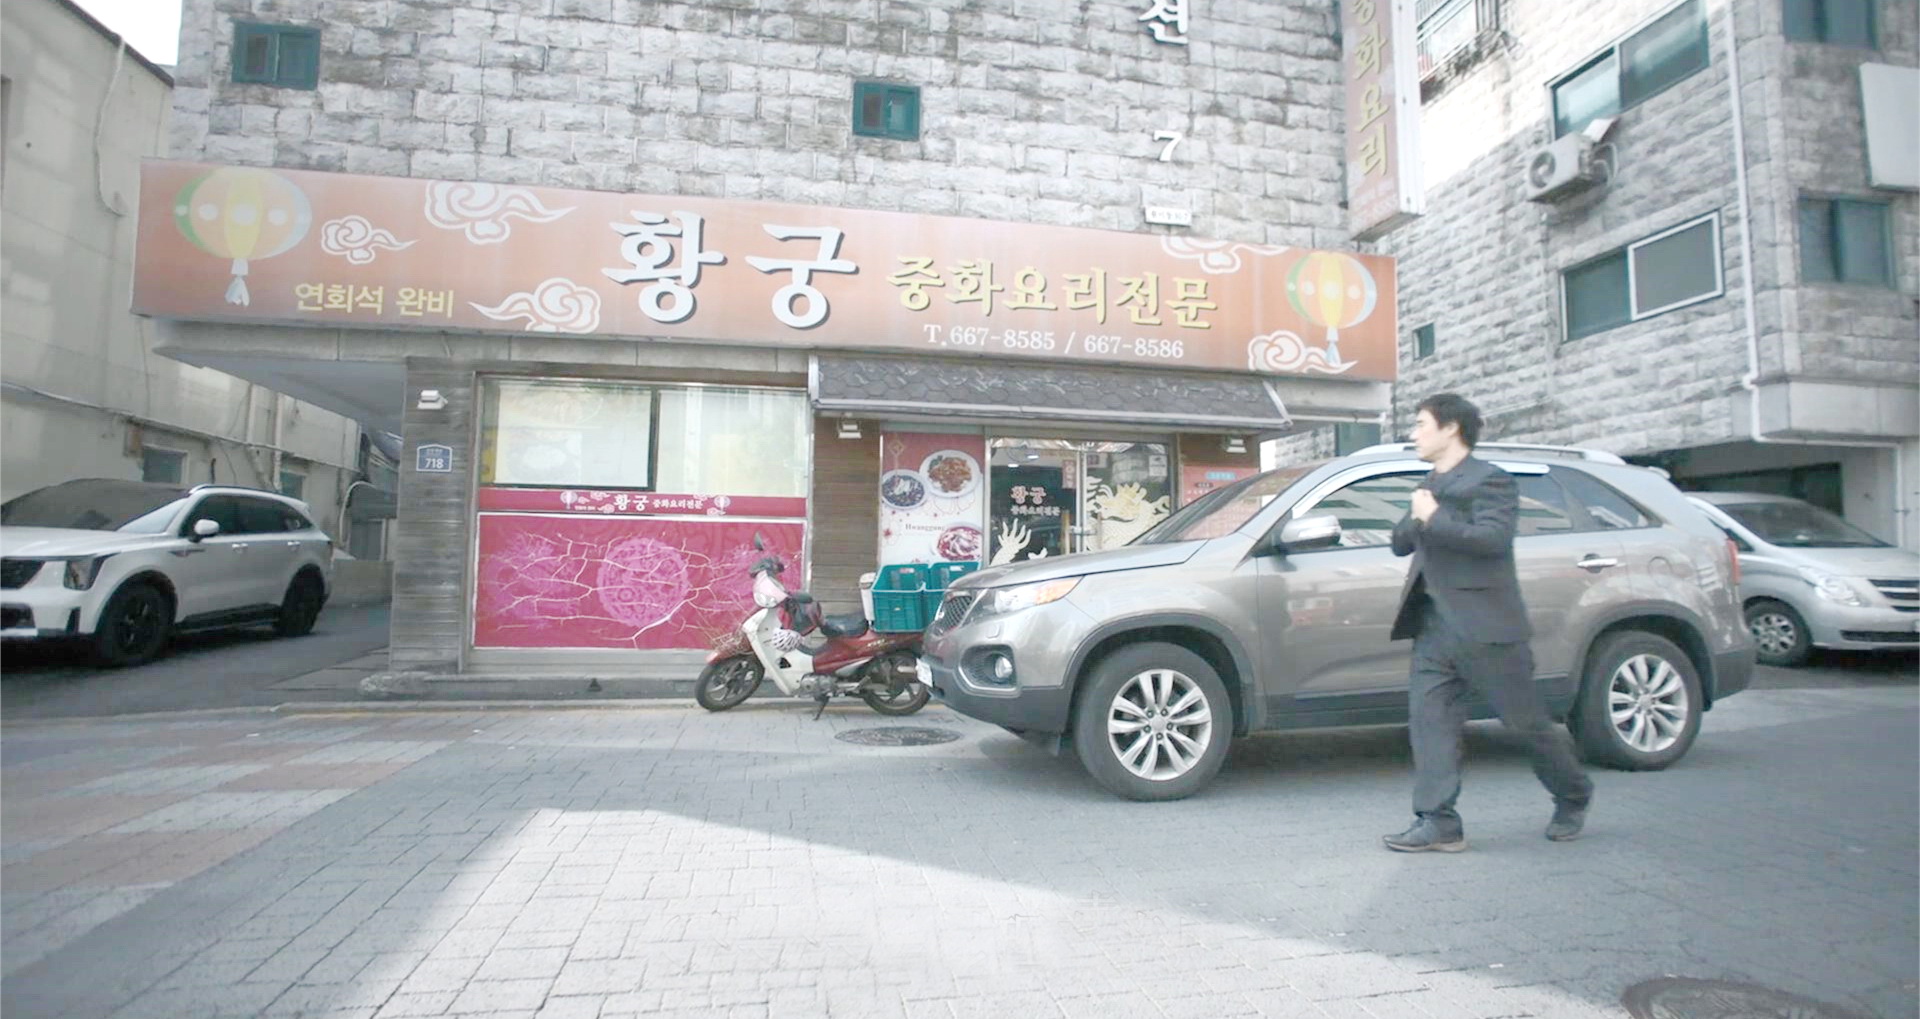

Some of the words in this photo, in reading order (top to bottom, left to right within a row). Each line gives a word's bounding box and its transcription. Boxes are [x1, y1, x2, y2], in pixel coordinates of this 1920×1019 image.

[1152, 130, 1183, 162] 7
[294, 282, 385, 316] 연회석
[395, 286, 455, 319] 완비
[885, 256, 1219, 329] 중화요리전문
[1083, 334, 1185, 359] 667-8586
[424, 457, 445, 469] 718
